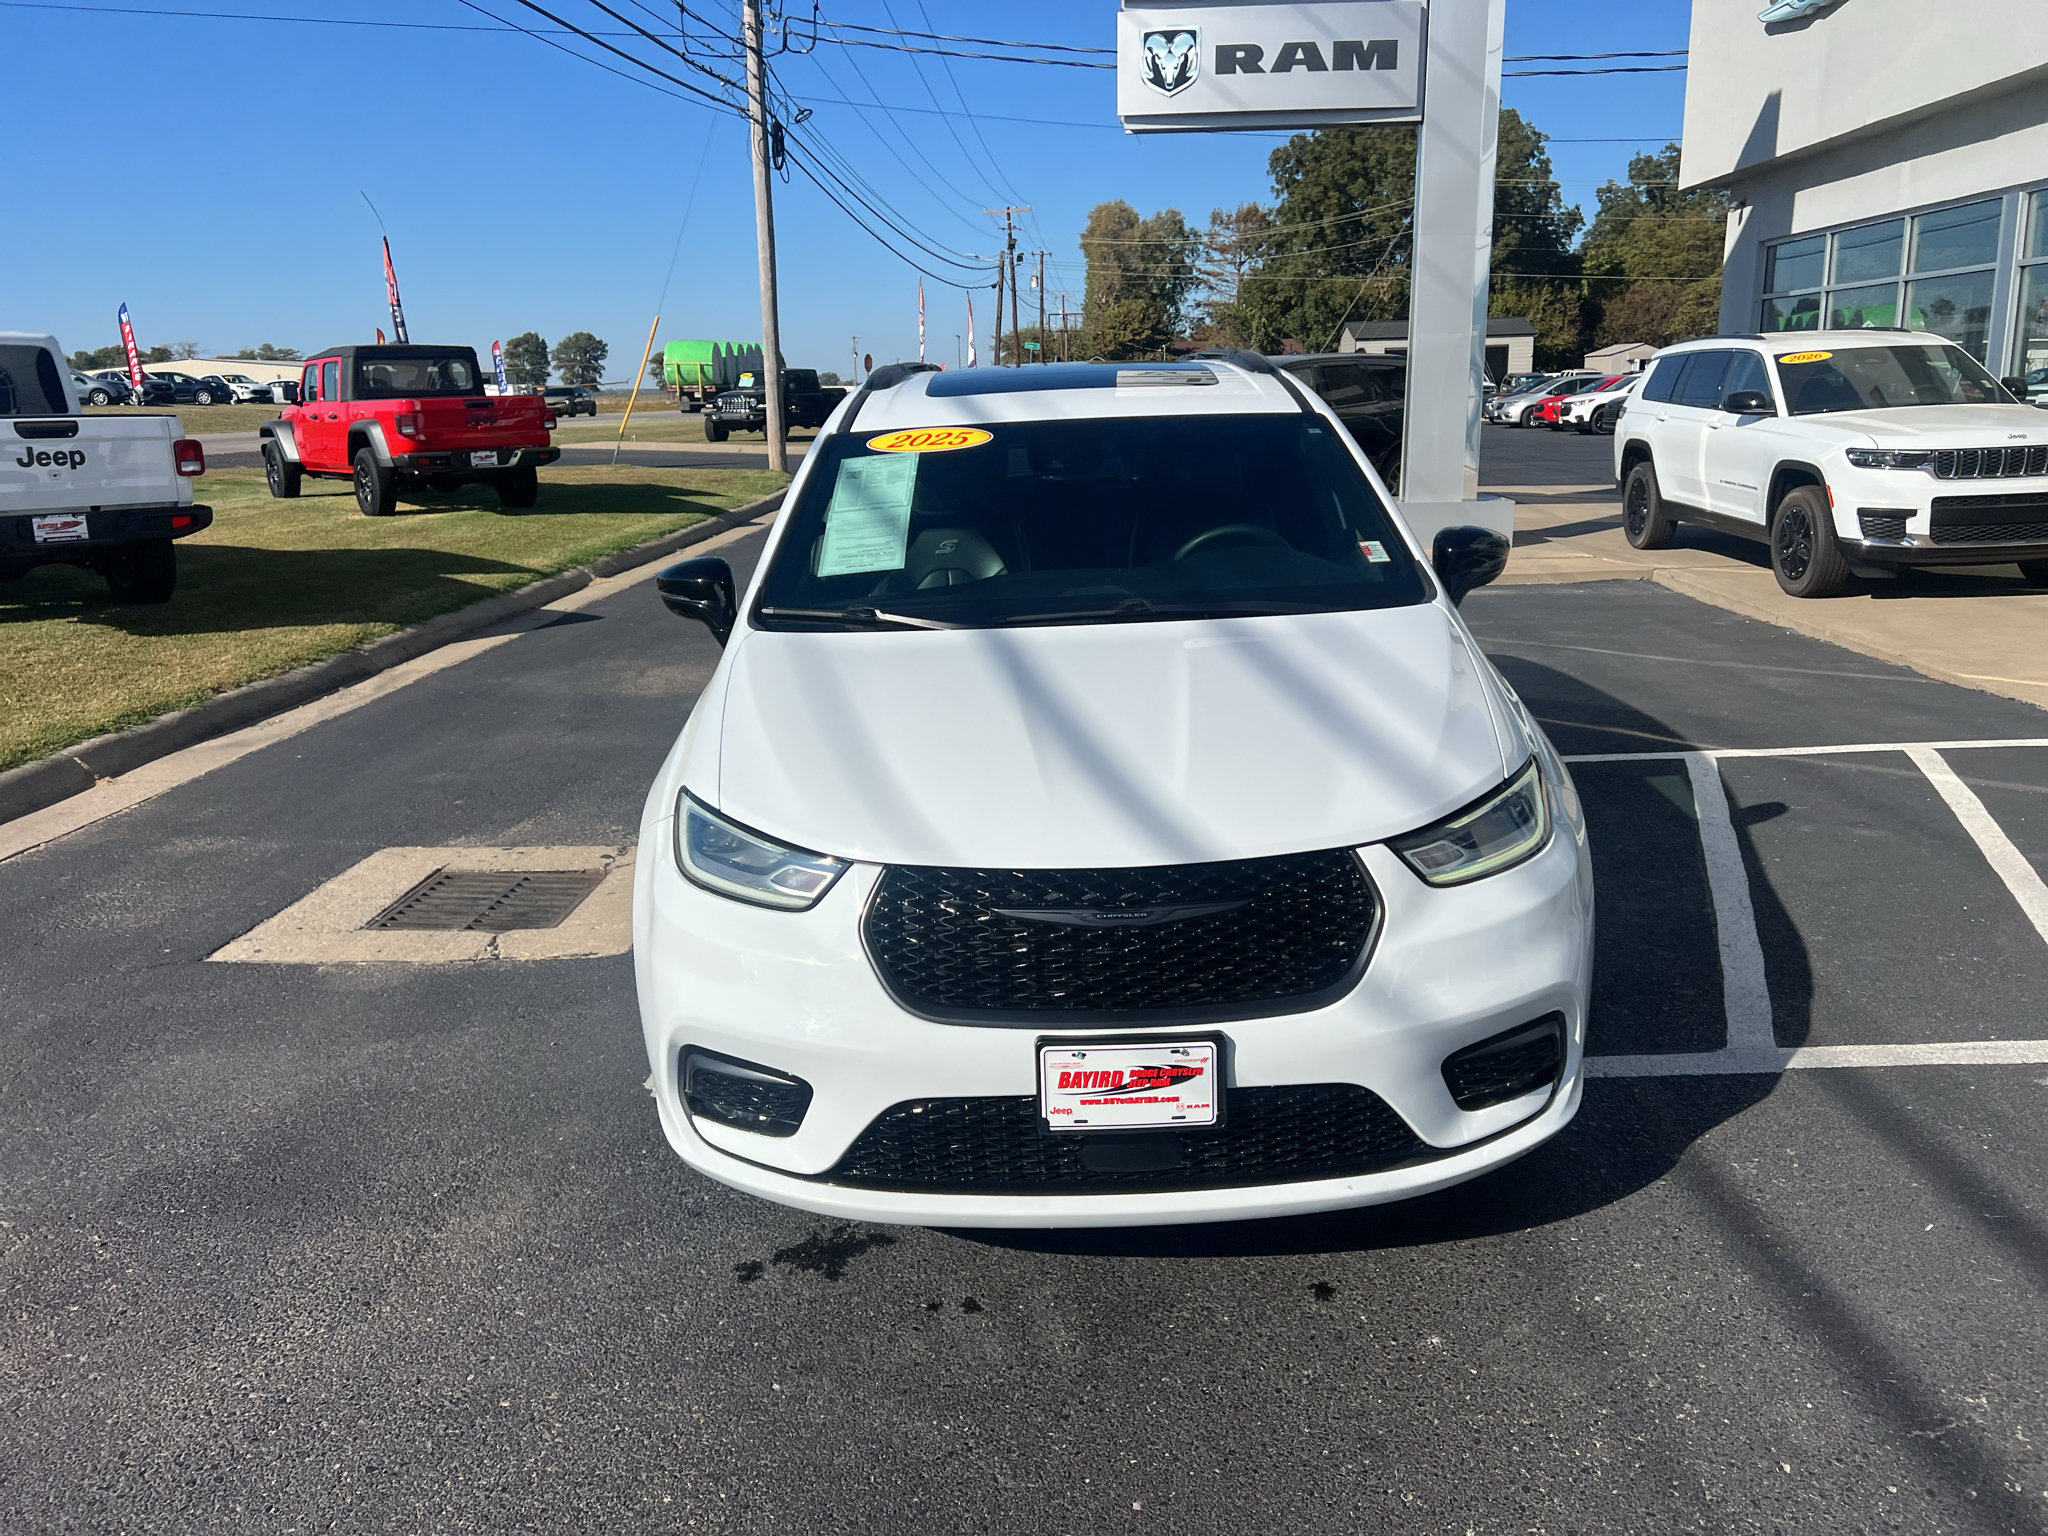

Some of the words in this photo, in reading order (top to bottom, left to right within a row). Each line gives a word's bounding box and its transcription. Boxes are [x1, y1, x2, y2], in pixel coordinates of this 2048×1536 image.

[1215, 39, 1399, 75] RAM
[1789, 353, 1822, 362] 2026
[887, 431, 975, 449] 2025
[16, 446, 86, 470] Jeep
[1058, 1070, 1124, 1089] BAYIRD
[1129, 1069, 1158, 1079] DODGE
[1159, 1067, 1204, 1077] CHRYSLER
[1126, 1078, 1149, 1089] JEEP
[1149, 1078, 1172, 1088] RAM
[1050, 1106, 1073, 1116] Jeep
